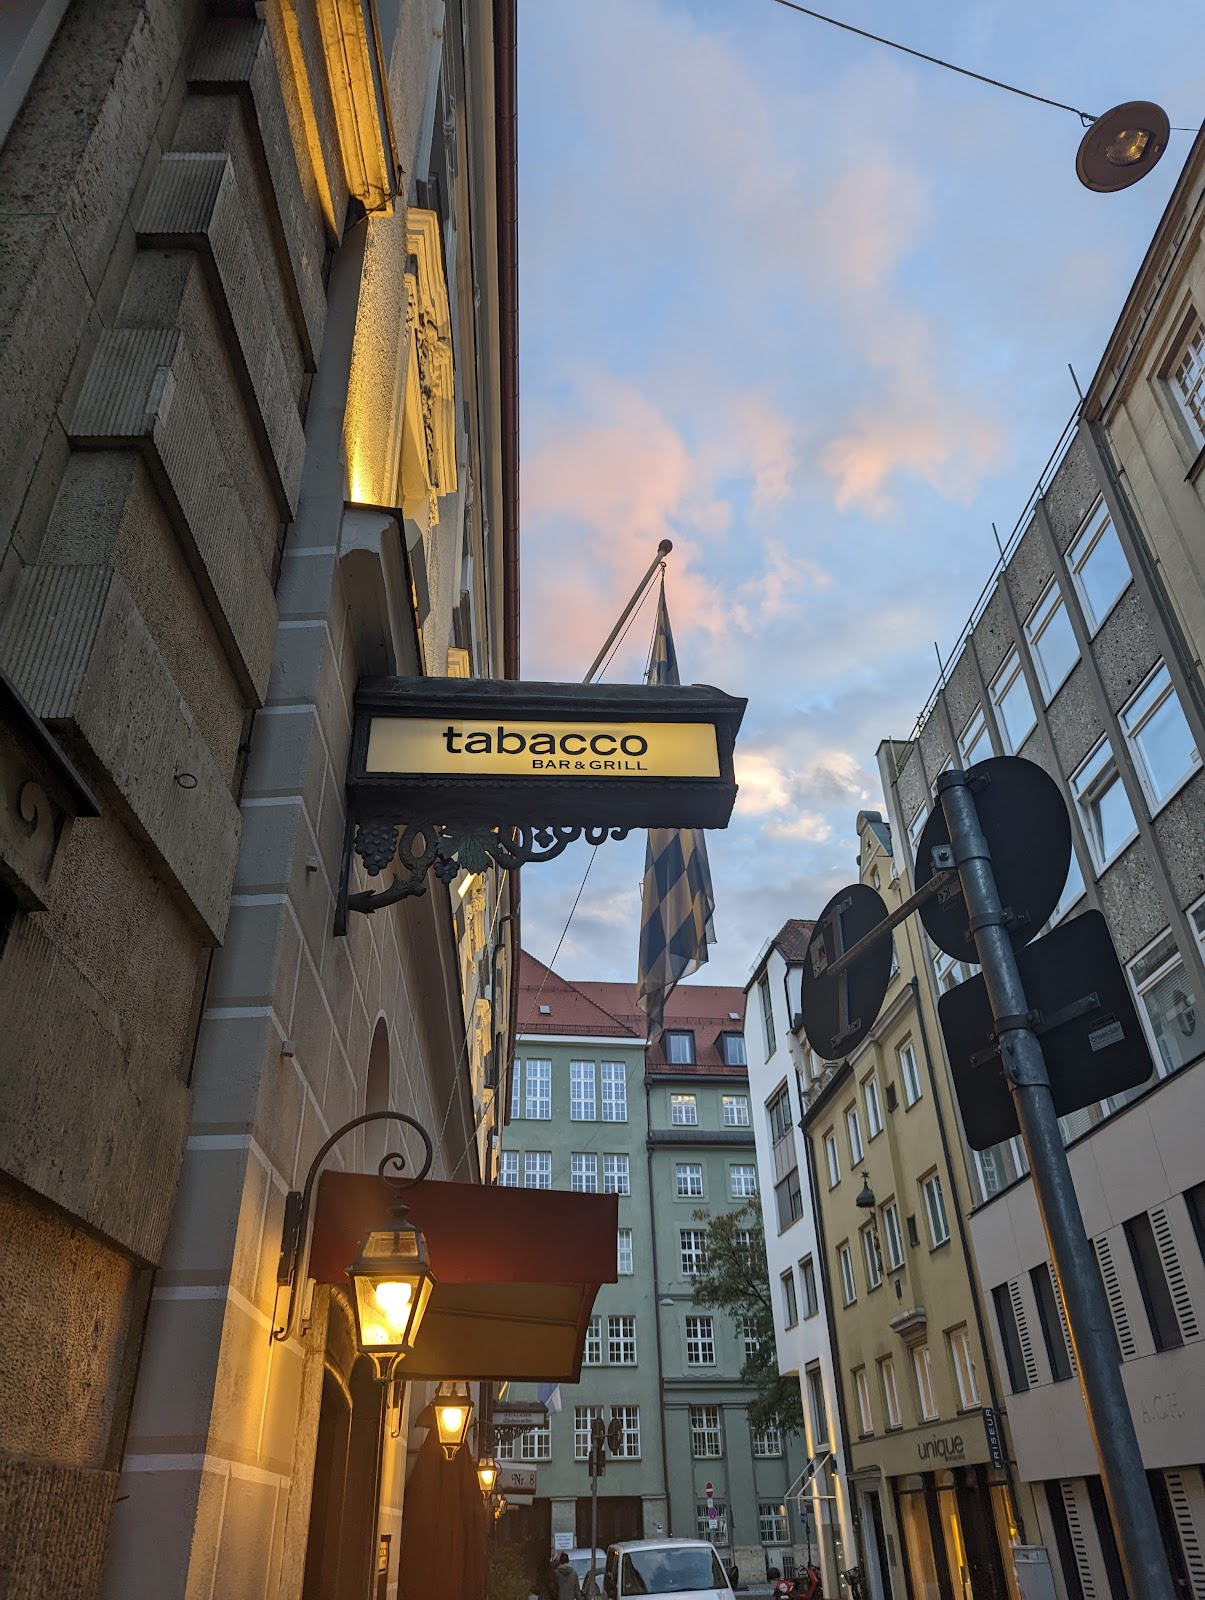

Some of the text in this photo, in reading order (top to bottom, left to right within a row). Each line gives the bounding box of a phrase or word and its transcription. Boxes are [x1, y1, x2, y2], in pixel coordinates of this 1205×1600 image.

[443, 726, 648, 757] tabacco
[917, 1433, 964, 1462] unique
[985, 1408, 1002, 1468] FRISEUR
[512, 1474, 535, 1486] Nr. 8
